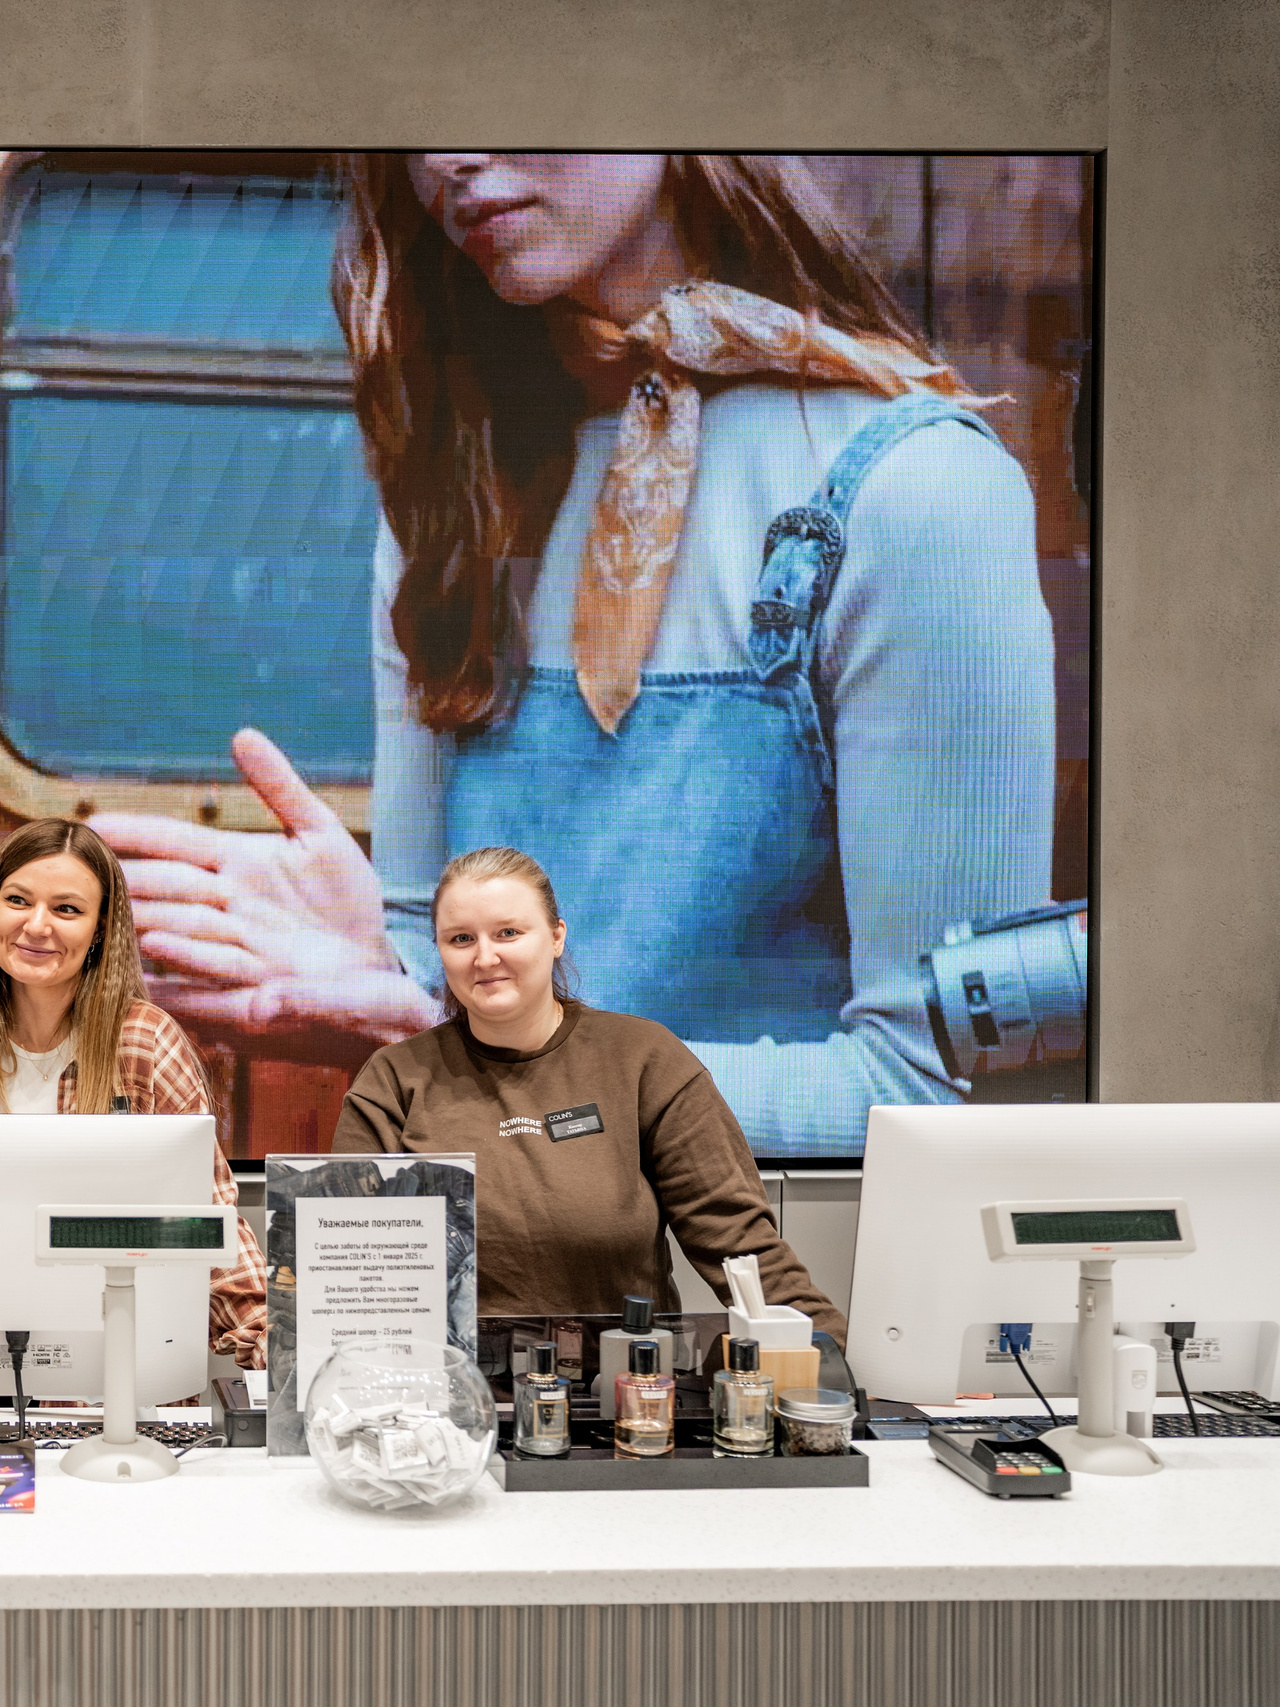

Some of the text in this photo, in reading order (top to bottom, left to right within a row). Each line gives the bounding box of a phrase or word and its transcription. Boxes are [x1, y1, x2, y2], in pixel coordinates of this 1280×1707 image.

[548, 1111, 573, 1122] COLIN'S
[499, 1117, 542, 1128] NOWHERE
[498, 1126, 542, 1137] NOWHERE
[318, 1217, 369, 1228] Уважаемые
[320, 1242, 338, 1251] целью
[340, 1242, 361, 1251] заботы
[362, 1242, 370, 1251] об
[370, 1242, 409, 1251] окружающей
[411, 1242, 428, 1251] среде
[319, 1252, 348, 1262] компания
[349, 1252, 372, 1262] COLIN'S
[383, 1252, 404, 1262] января
[404, 1252, 418, 1262] 2025
[308, 1263, 435, 1272] приостанавливает выдачу полиэтиленовых
[324, 1285, 420, 1294] Для Вашего удобства мы можем
[325, 1296, 418, 1304] предложить Вам многоразовые
[311, 1307, 336, 1315] шоперы
[336, 1307, 345, 1315] по
[345, 1307, 410, 1315] нижепредставленным
[331, 1327, 357, 1336] Средний
[357, 1327, 378, 1336] шопер
[383, 1327, 391, 1336] 25
[391, 1327, 413, 1336] рублей
